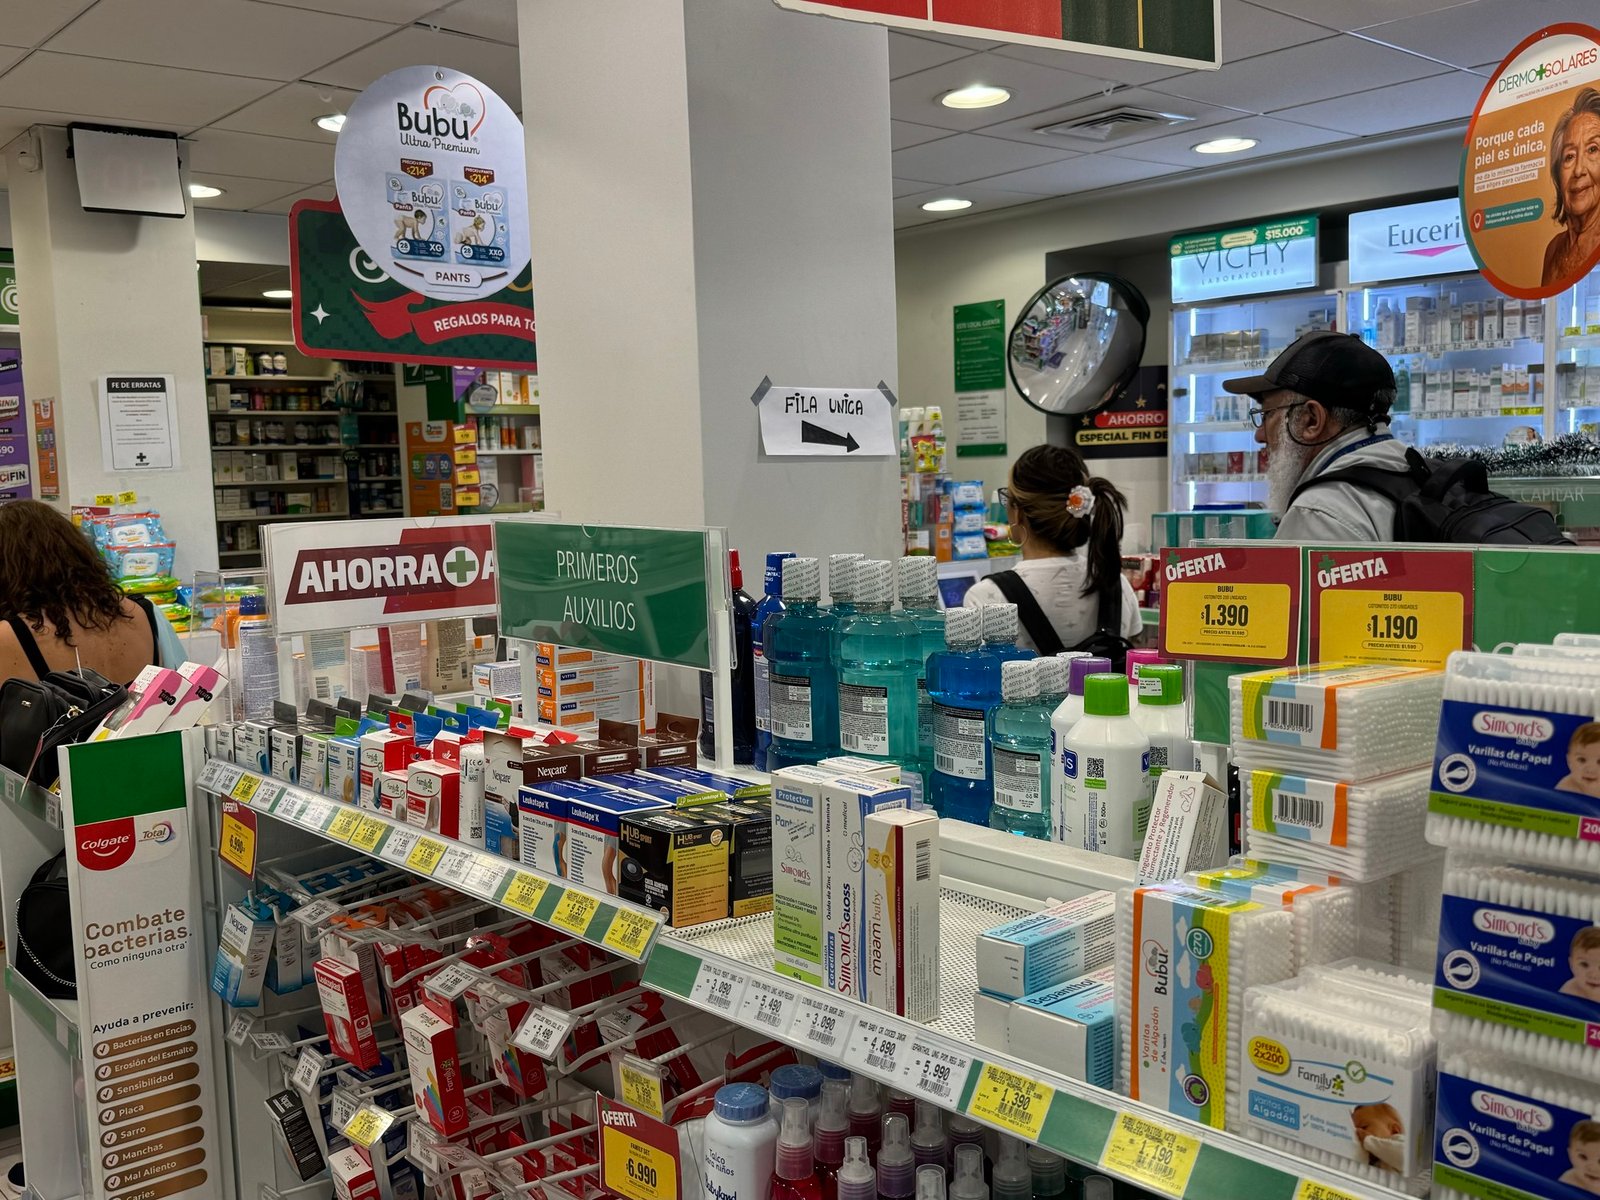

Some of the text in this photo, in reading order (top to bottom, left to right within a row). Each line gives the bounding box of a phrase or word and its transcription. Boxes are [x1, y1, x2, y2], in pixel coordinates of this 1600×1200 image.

[397, 103, 469, 140] Bubu
[400, 133, 480, 155] Ultra Premium
[1476, 119, 1544, 150] Porque cada
[1475, 139, 1546, 170] piel es única,
[1520, 159, 1544, 171] farmacia
[412, 192, 438, 205] Bubu
[475, 199, 499, 211] Bubu
[1265, 226, 1304, 240] $15.000
[1388, 215, 1460, 247] Euceri
[429, 243, 442, 252] XG
[489, 249, 503, 257] XXG
[1195, 240, 1290, 273] VICHY
[435, 271, 471, 283] PANTS
[1202, 268, 1285, 285] LABORATOIRES
[434, 313, 536, 333] REGALOS PARA TO
[1109, 413, 1164, 425] AHORRO
[1079, 430, 1167, 443] ESPECIAL FIN DE
[1, 470, 26, 481] CIFIN
[1520, 488, 1584, 502] CAPILAR
[297, 553, 442, 595] AHORRA
[556, 550, 638, 585] PRIMEROS
[1165, 553, 1226, 581] OFERTA
[1317, 556, 1389, 588] OFERTA
[563, 595, 636, 632] AUXILIOS
[1201, 604, 1249, 626] $1.390
[1367, 615, 1417, 639] $1.190
[1481, 713, 1544, 738] Simond's
[1516, 736, 1539, 749] baby
[1468, 744, 1552, 766] Varillas de Papel
[492, 769, 511, 784] Nexcare
[537, 765, 567, 777] Nexcare
[522, 795, 544, 809] Leukotape
[779, 791, 809, 805] Protector
[571, 806, 595, 821] Leukotape
[81, 828, 166, 850] Colgate Total
[1140, 807, 1161, 877] Ungüento Protector
[1147, 783, 1174, 879] Humectante Regenerador
[780, 862, 811, 880] Simond's
[872, 890, 883, 921] baby
[86, 908, 185, 940] Combate
[228, 914, 248, 936] Nexcare
[1481, 911, 1546, 940] Simond's
[84, 926, 192, 960] bacterias.
[873, 923, 881, 976] maam
[1192, 932, 1202, 956] 270
[1518, 936, 1540, 949] baby
[90, 948, 162, 970] Como ninguna
[795, 959, 808, 969] diario
[838, 921, 852, 995] Simond's
[1470, 941, 1555, 967] Varillas de Papel
[1155, 952, 1169, 996] Bubu
[711, 978, 732, 996] 3.090
[1027, 978, 1097, 1006] Bepanthol
[760, 995, 782, 1012] 5.490
[93, 1002, 194, 1034] Ayuda a prevenir:
[812, 1013, 835, 1031] 3.090
[112, 1022, 192, 1050] Bacterias en Encías
[1142, 1024, 1150, 1058] Varitas
[1151, 1006, 1159, 1062] de Algodón
[870, 1036, 896, 1056] 4.890
[1253, 1047, 1284, 1065] 2x200
[1255, 1041, 1282, 1054] OFERTA
[114, 1045, 194, 1073] Erosión del Esmalte
[922, 1060, 951, 1081] 5.990
[1297, 1067, 1332, 1090] Family
[117, 1073, 174, 1096] Sensibilidad
[1001, 1088, 1031, 1110] 1.390
[1254, 1095, 1296, 1115] Varitas de
[1480, 1093, 1543, 1127] Simond's
[119, 1104, 144, 1117] Placa
[602, 1110, 637, 1127] OFERTA
[1253, 1104, 1296, 1124] Algodón
[120, 1126, 146, 1139] Sarro
[1469, 1121, 1554, 1156] Varillas de Papel
[1516, 1123, 1538, 1137] baby
[122, 1143, 164, 1161] Manchas
[709, 1149, 726, 1165] Talco
[1139, 1140, 1173, 1165] 1.190
[124, 1160, 177, 1183] Mal Aliento
[626, 1158, 657, 1188] $6.990
[716, 1162, 735, 1177] niños
[126, 1189, 155, 1200] Caries
